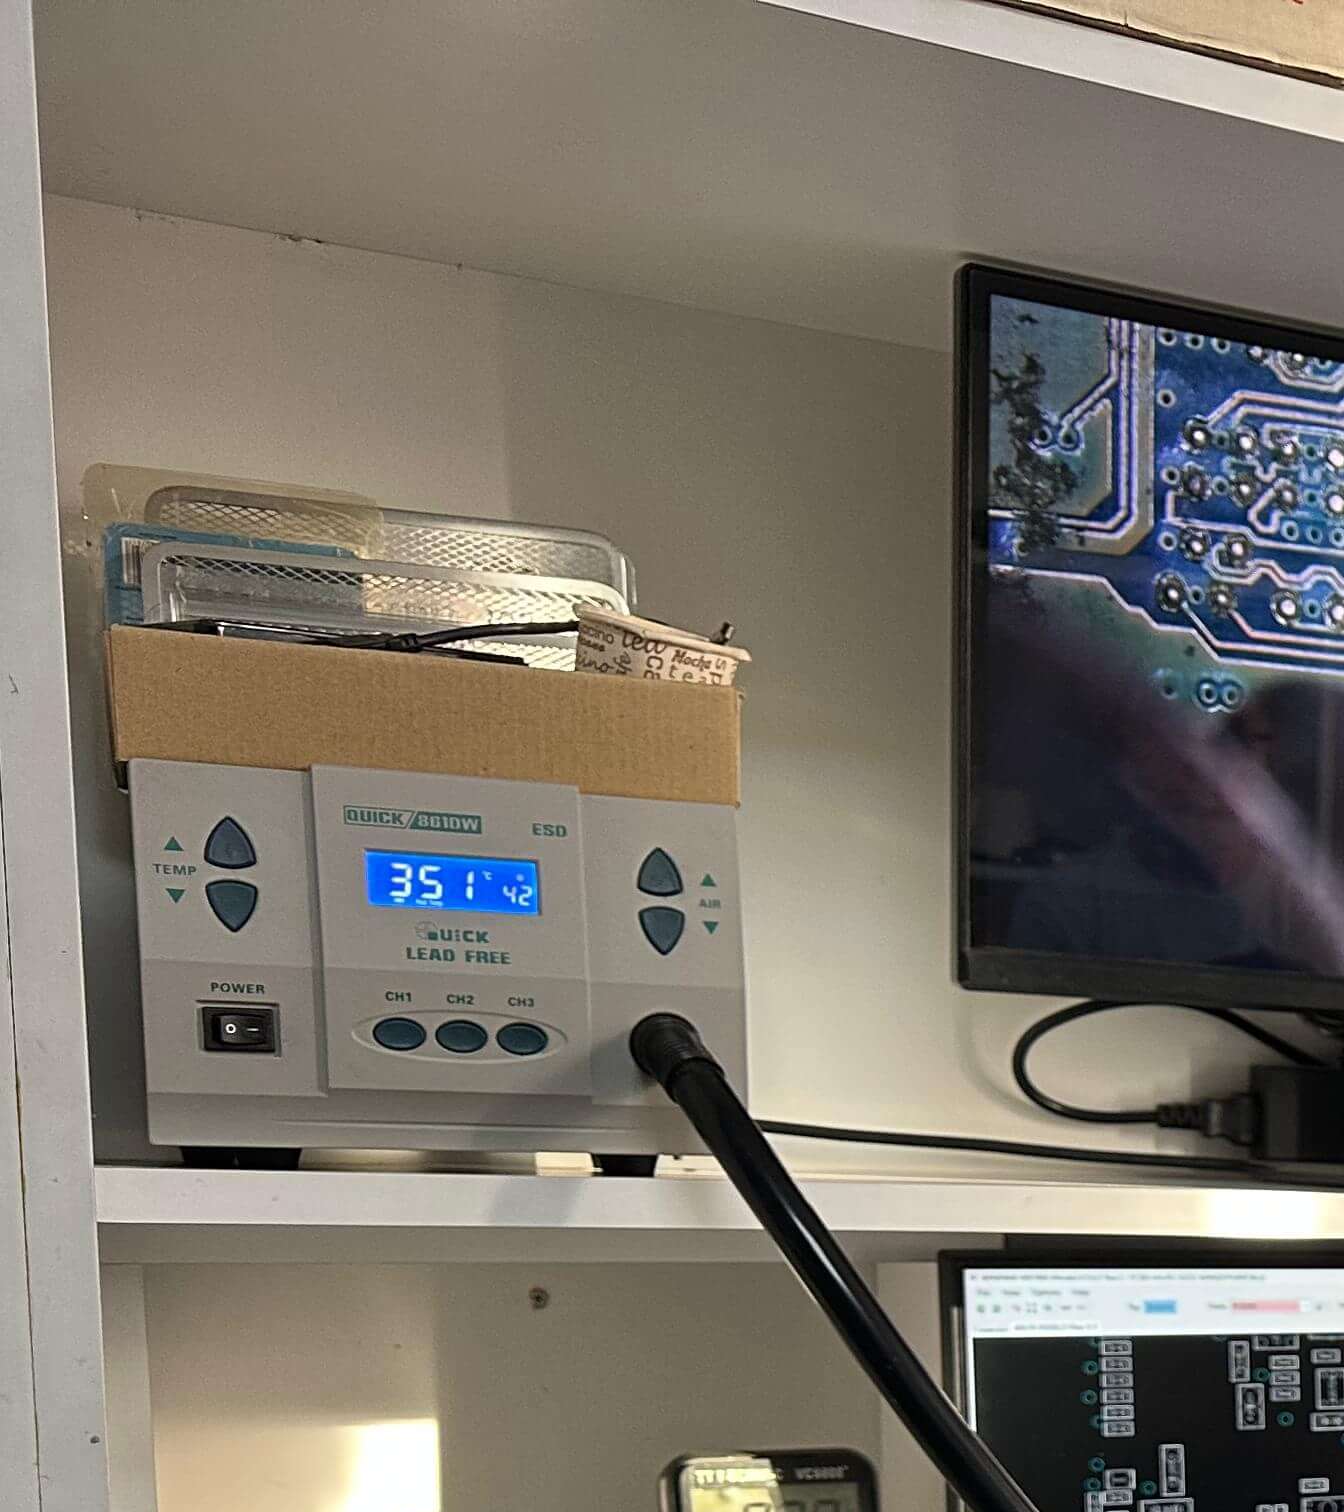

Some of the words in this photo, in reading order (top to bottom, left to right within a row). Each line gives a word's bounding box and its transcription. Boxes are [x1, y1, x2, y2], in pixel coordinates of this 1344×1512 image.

[346, 809, 405, 825] QUICK
[532, 823, 567, 837] ESD
[152, 863, 197, 876] TEMP
[389, 862, 475, 901] 351
[503, 885, 533, 906] 42
[699, 899, 721, 910] AIR
[406, 946, 455, 962] LEAD
[465, 950, 512, 965] FREE
[210, 982, 265, 994] POWER
[385, 991, 412, 1002] CH1
[446, 994, 475, 1005] CH2
[507, 996, 535, 1008] CH3
